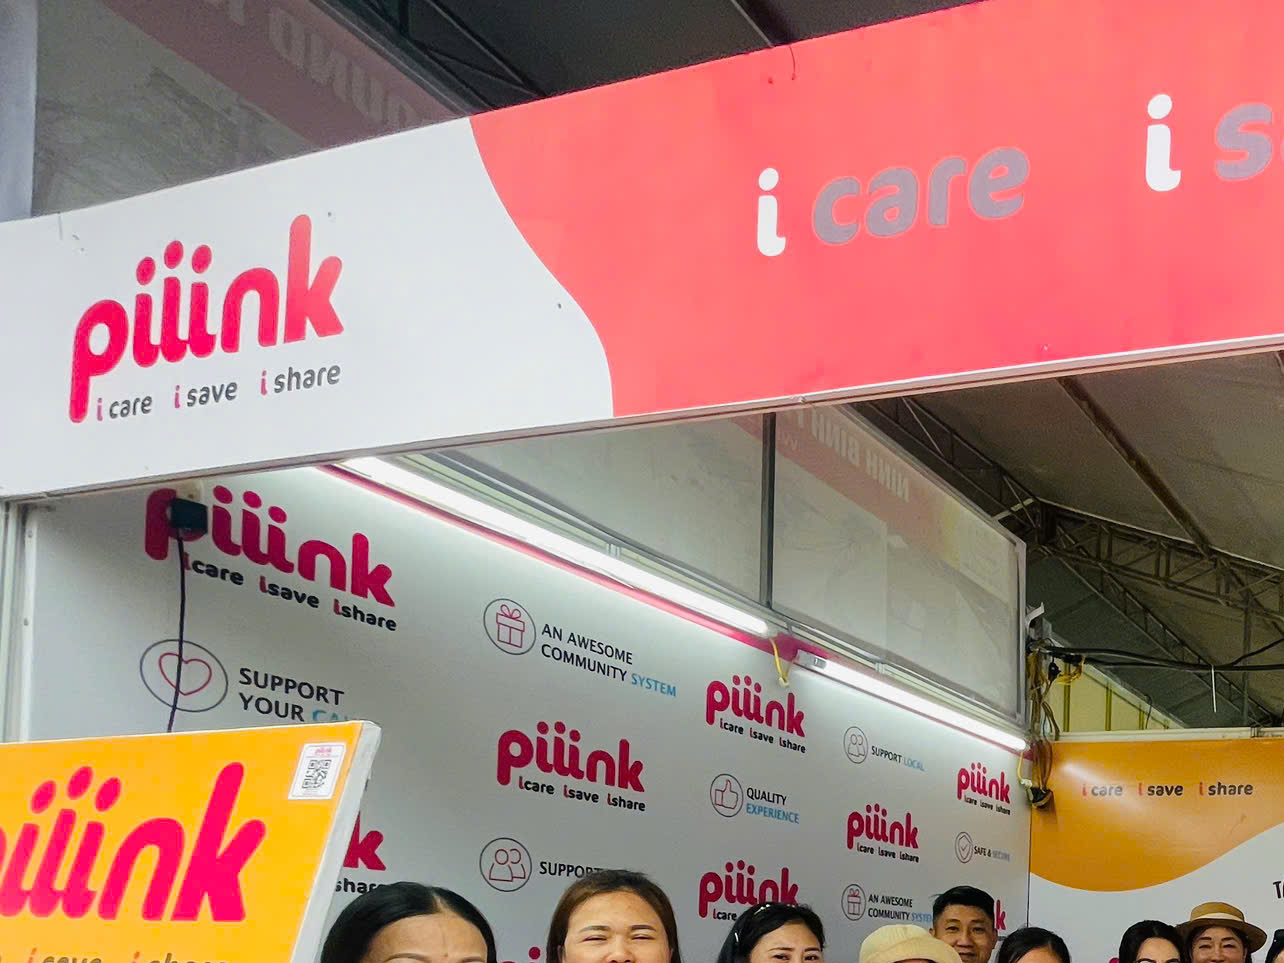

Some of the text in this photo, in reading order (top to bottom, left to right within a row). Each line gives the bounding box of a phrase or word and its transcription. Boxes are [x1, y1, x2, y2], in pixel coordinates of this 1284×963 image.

[1145, 93, 1182, 193] i
[756, 146, 1031, 257] i care
[69, 213, 345, 424] piiink
[97, 362, 342, 421] i care i save i share
[541, 623, 634, 666] AN AWESOME
[238, 667, 345, 706] SUPPORT
[540, 643, 678, 698] COMMUNITY SYSTEM
[238, 692, 305, 722] YOUR
[705, 673, 806, 738] piiink
[497, 720, 646, 793] piiink
[871, 745, 902, 764] SUPPORT
[746, 787, 788, 806] QUALITY
[957, 762, 1011, 804] piiink
[1090, 783, 1123, 797] care
[1147, 782, 1184, 797] save
[1207, 781, 1254, 797] share
[745, 803, 800, 824] EXPERIENCE
[847, 803, 920, 850] piiink
[0, 761, 267, 922] iiink
[973, 846, 987, 857] SAFE
[868, 894, 913, 908] AN AWESOME
[868, 907, 933, 924] COMMUNITY SYSTE
